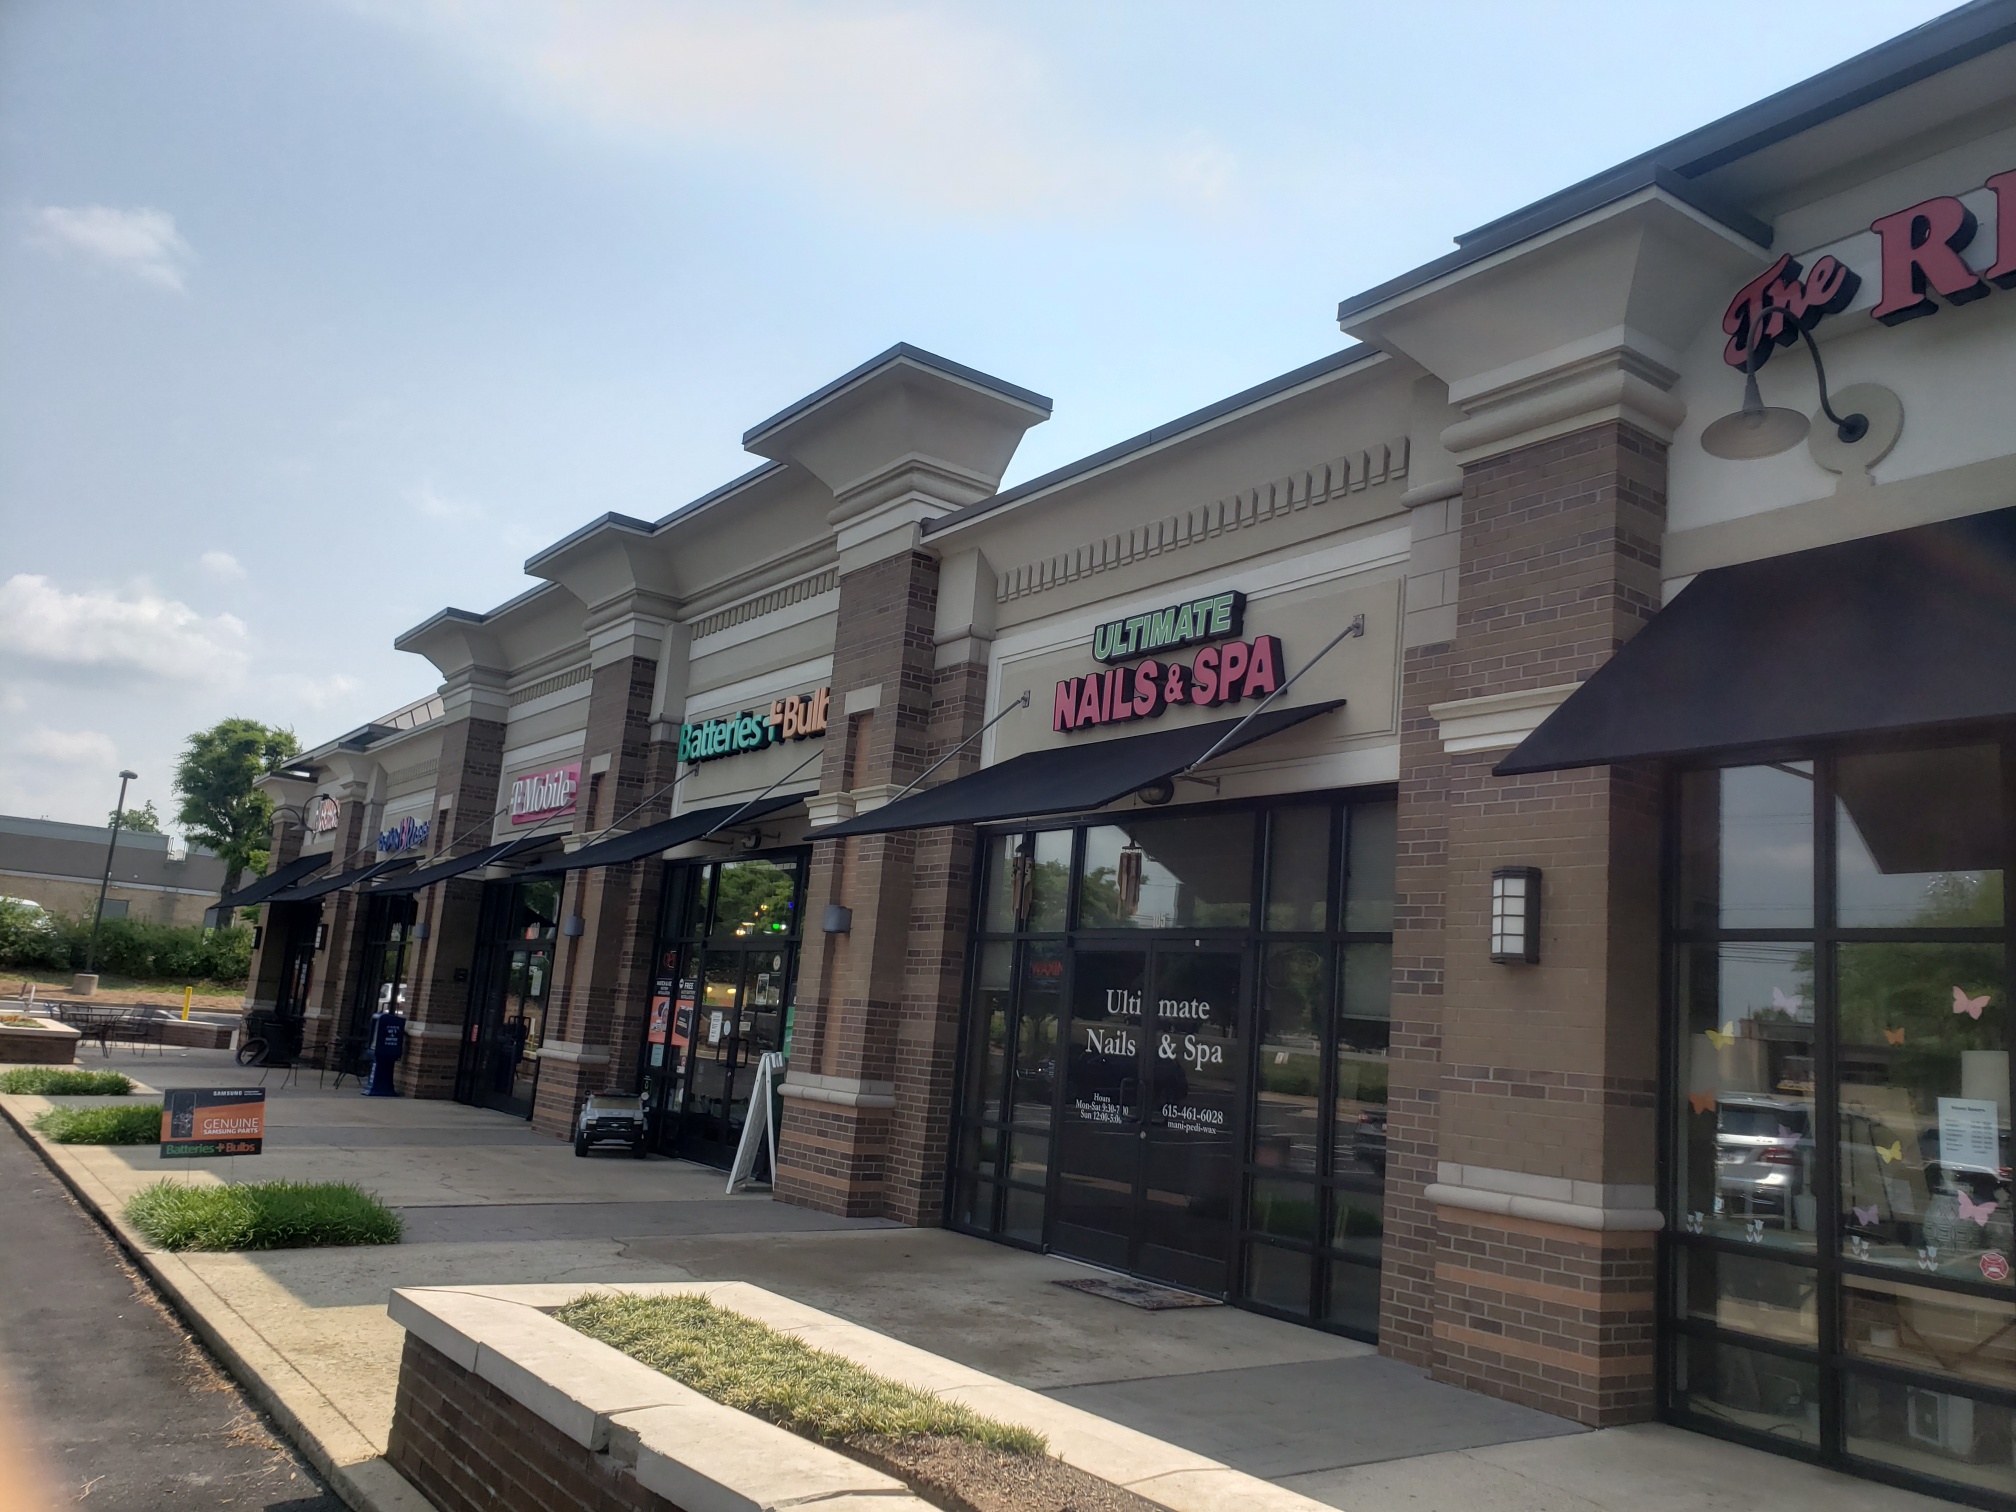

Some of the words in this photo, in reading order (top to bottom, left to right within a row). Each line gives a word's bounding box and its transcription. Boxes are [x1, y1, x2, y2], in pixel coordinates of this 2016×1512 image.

[1094, 593, 1234, 661] ULTIMATE
[1053, 659, 1159, 731] NAILS
[1164, 663, 1184, 703] &
[1190, 634, 1276, 705] SPA
[677, 711, 763, 762] Batteries
[510, 769, 572, 815] T-Mobile
[1153, 914, 1166, 928] 105
[1085, 1028, 1136, 1057] Nails
[1158, 1034, 1177, 1060] &
[1184, 1034, 1223, 1071] Spa
[1075, 1098, 1101, 1112] Mon-Sat
[1093, 1092, 1111, 1103] Hours
[1080, 1109, 1092, 1120] Sun
[1162, 1103, 1224, 1125] 615-461-6028
[203, 1118, 259, 1129] GENUINE
[1167, 1120, 1217, 1135] mani-pedi-wax
[166, 1144, 215, 1154] Batteries
[225, 1142, 255, 1152] Bulbs
